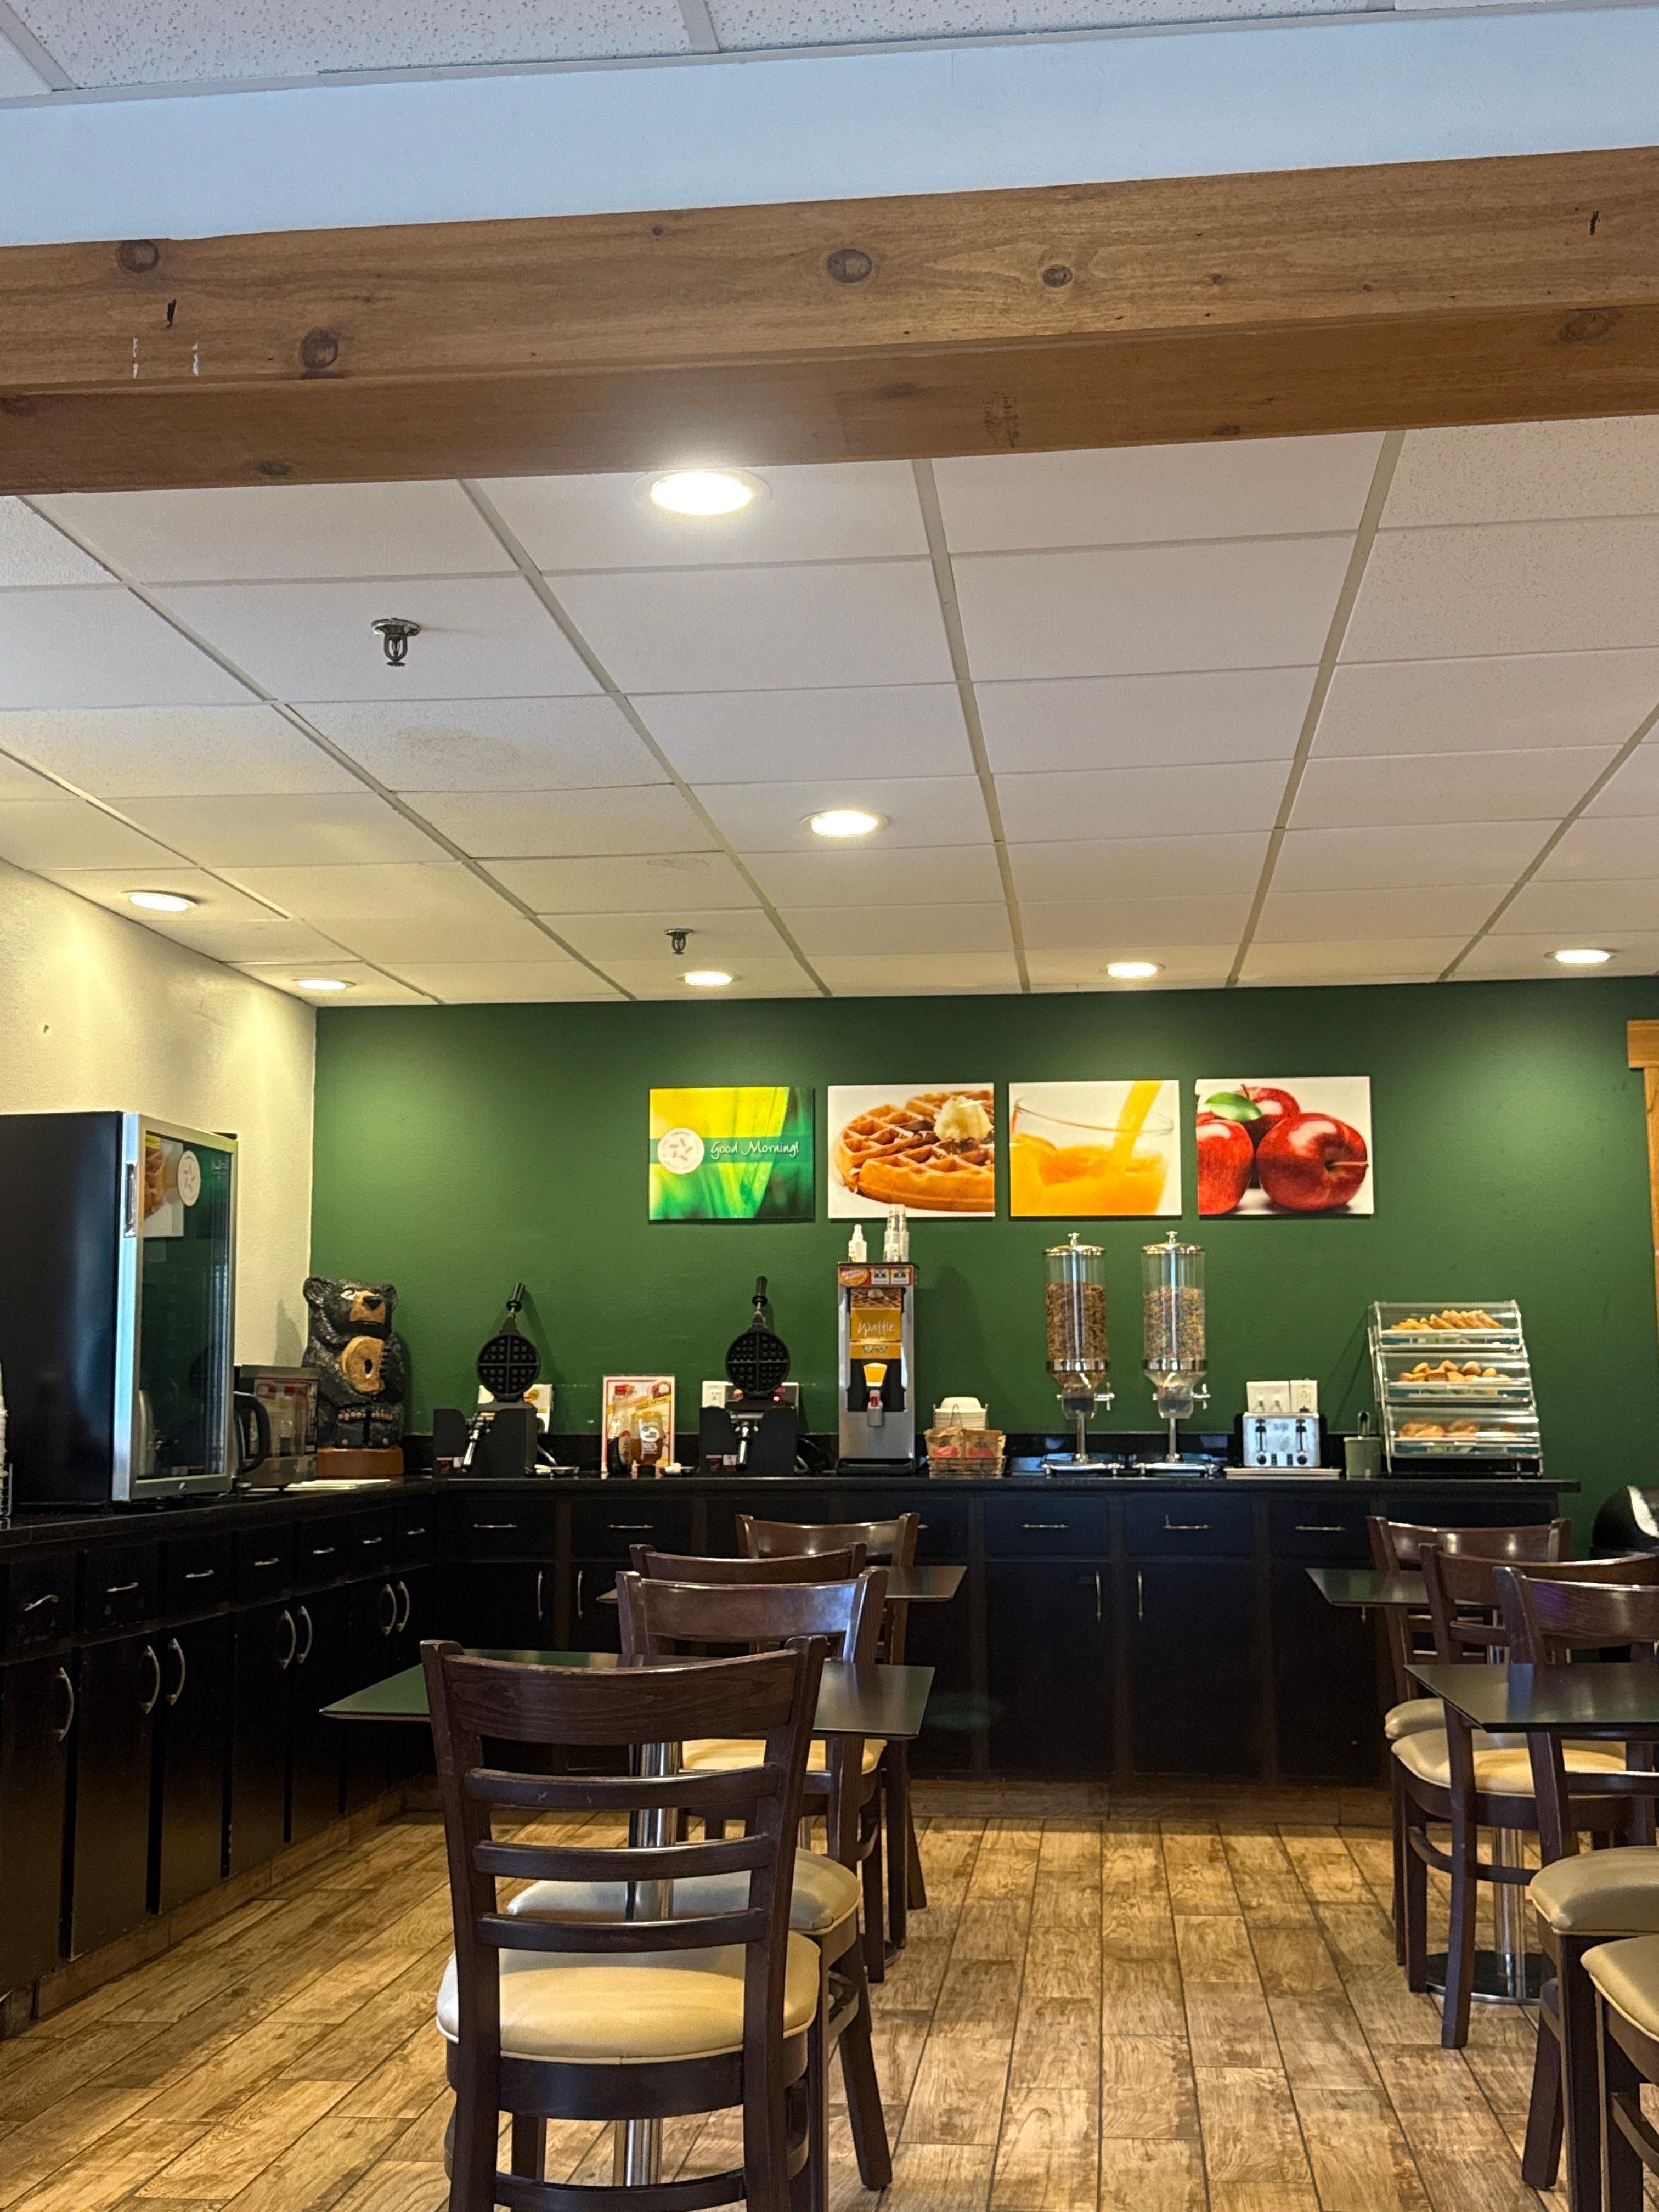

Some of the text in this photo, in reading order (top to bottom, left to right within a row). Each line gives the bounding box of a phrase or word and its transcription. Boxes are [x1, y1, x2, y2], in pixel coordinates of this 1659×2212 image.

[710, 1140, 800, 1159] Good Morning!
[857, 1319, 895, 1337] Waffle
